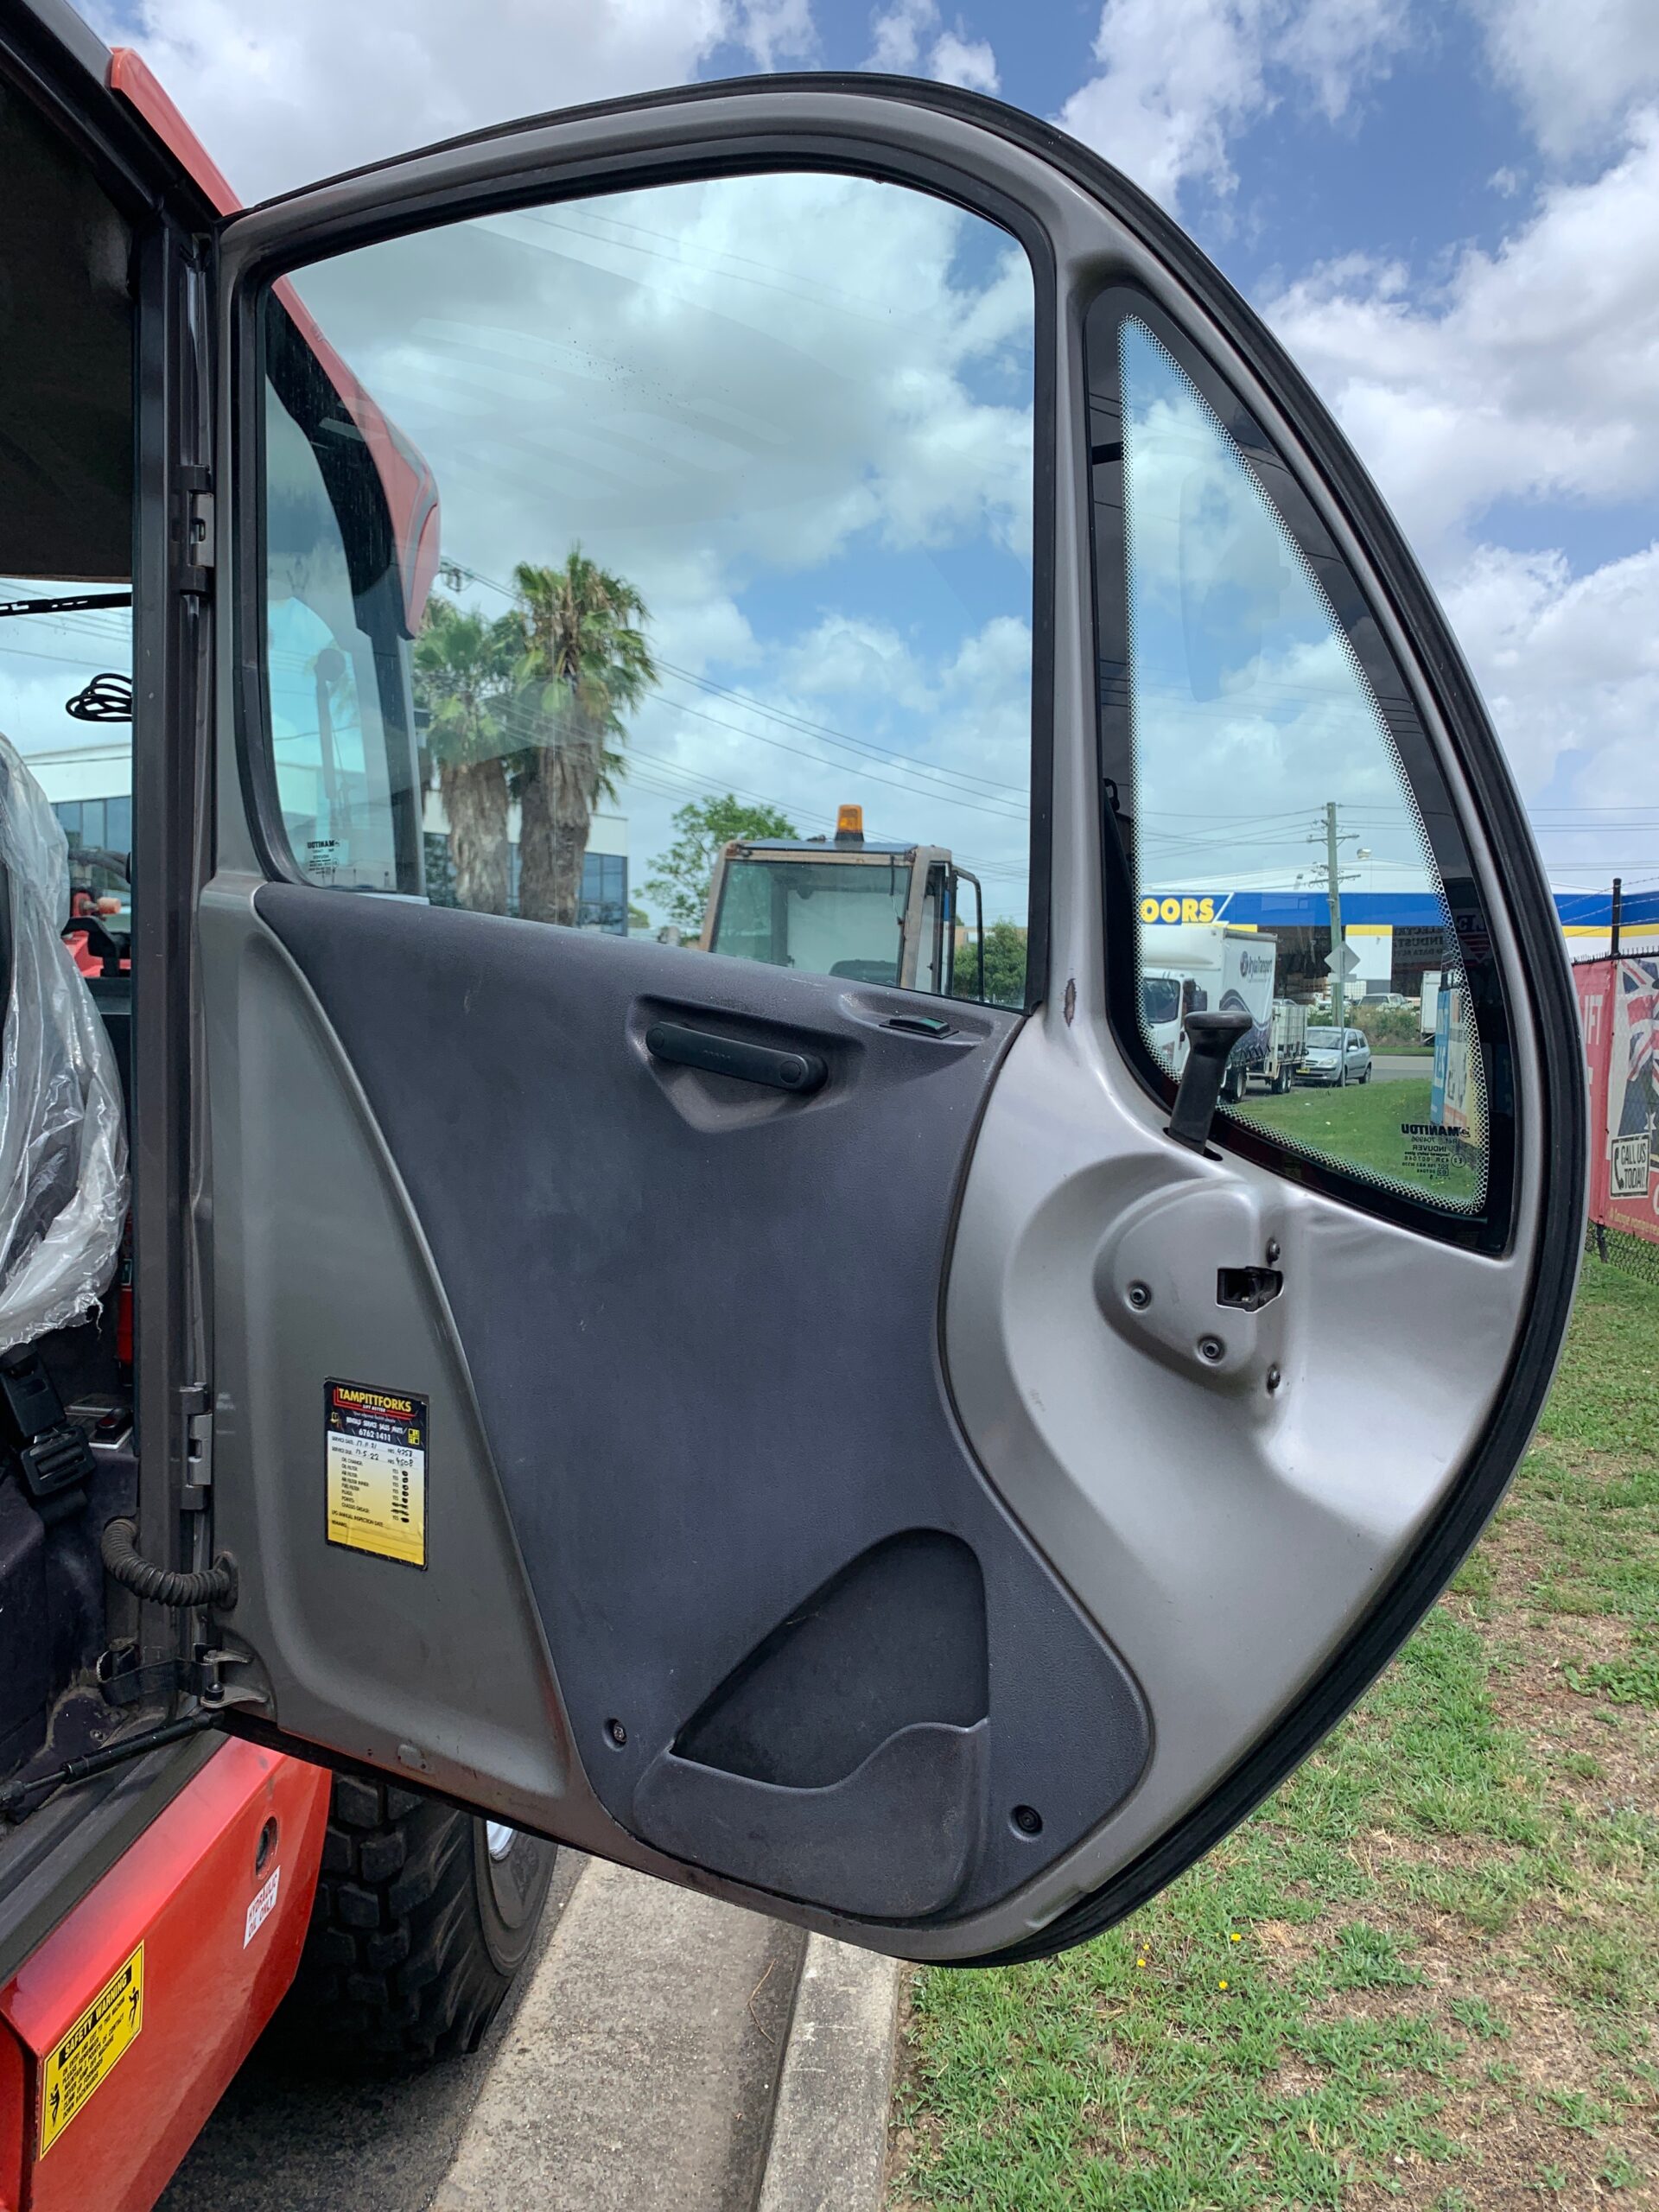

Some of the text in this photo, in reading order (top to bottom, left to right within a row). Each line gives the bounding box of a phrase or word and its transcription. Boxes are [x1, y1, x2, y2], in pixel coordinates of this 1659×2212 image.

[1141, 898, 1214, 923] OORS
[1581, 995, 1604, 1045] IFT
[1621, 1143, 1646, 1165] CALL US
[339, 1388, 411, 1412] TAMPITTFORKS
[359, 1428, 375, 1437] 6762
[65, 1974, 126, 2058] SAFETY WARNING
